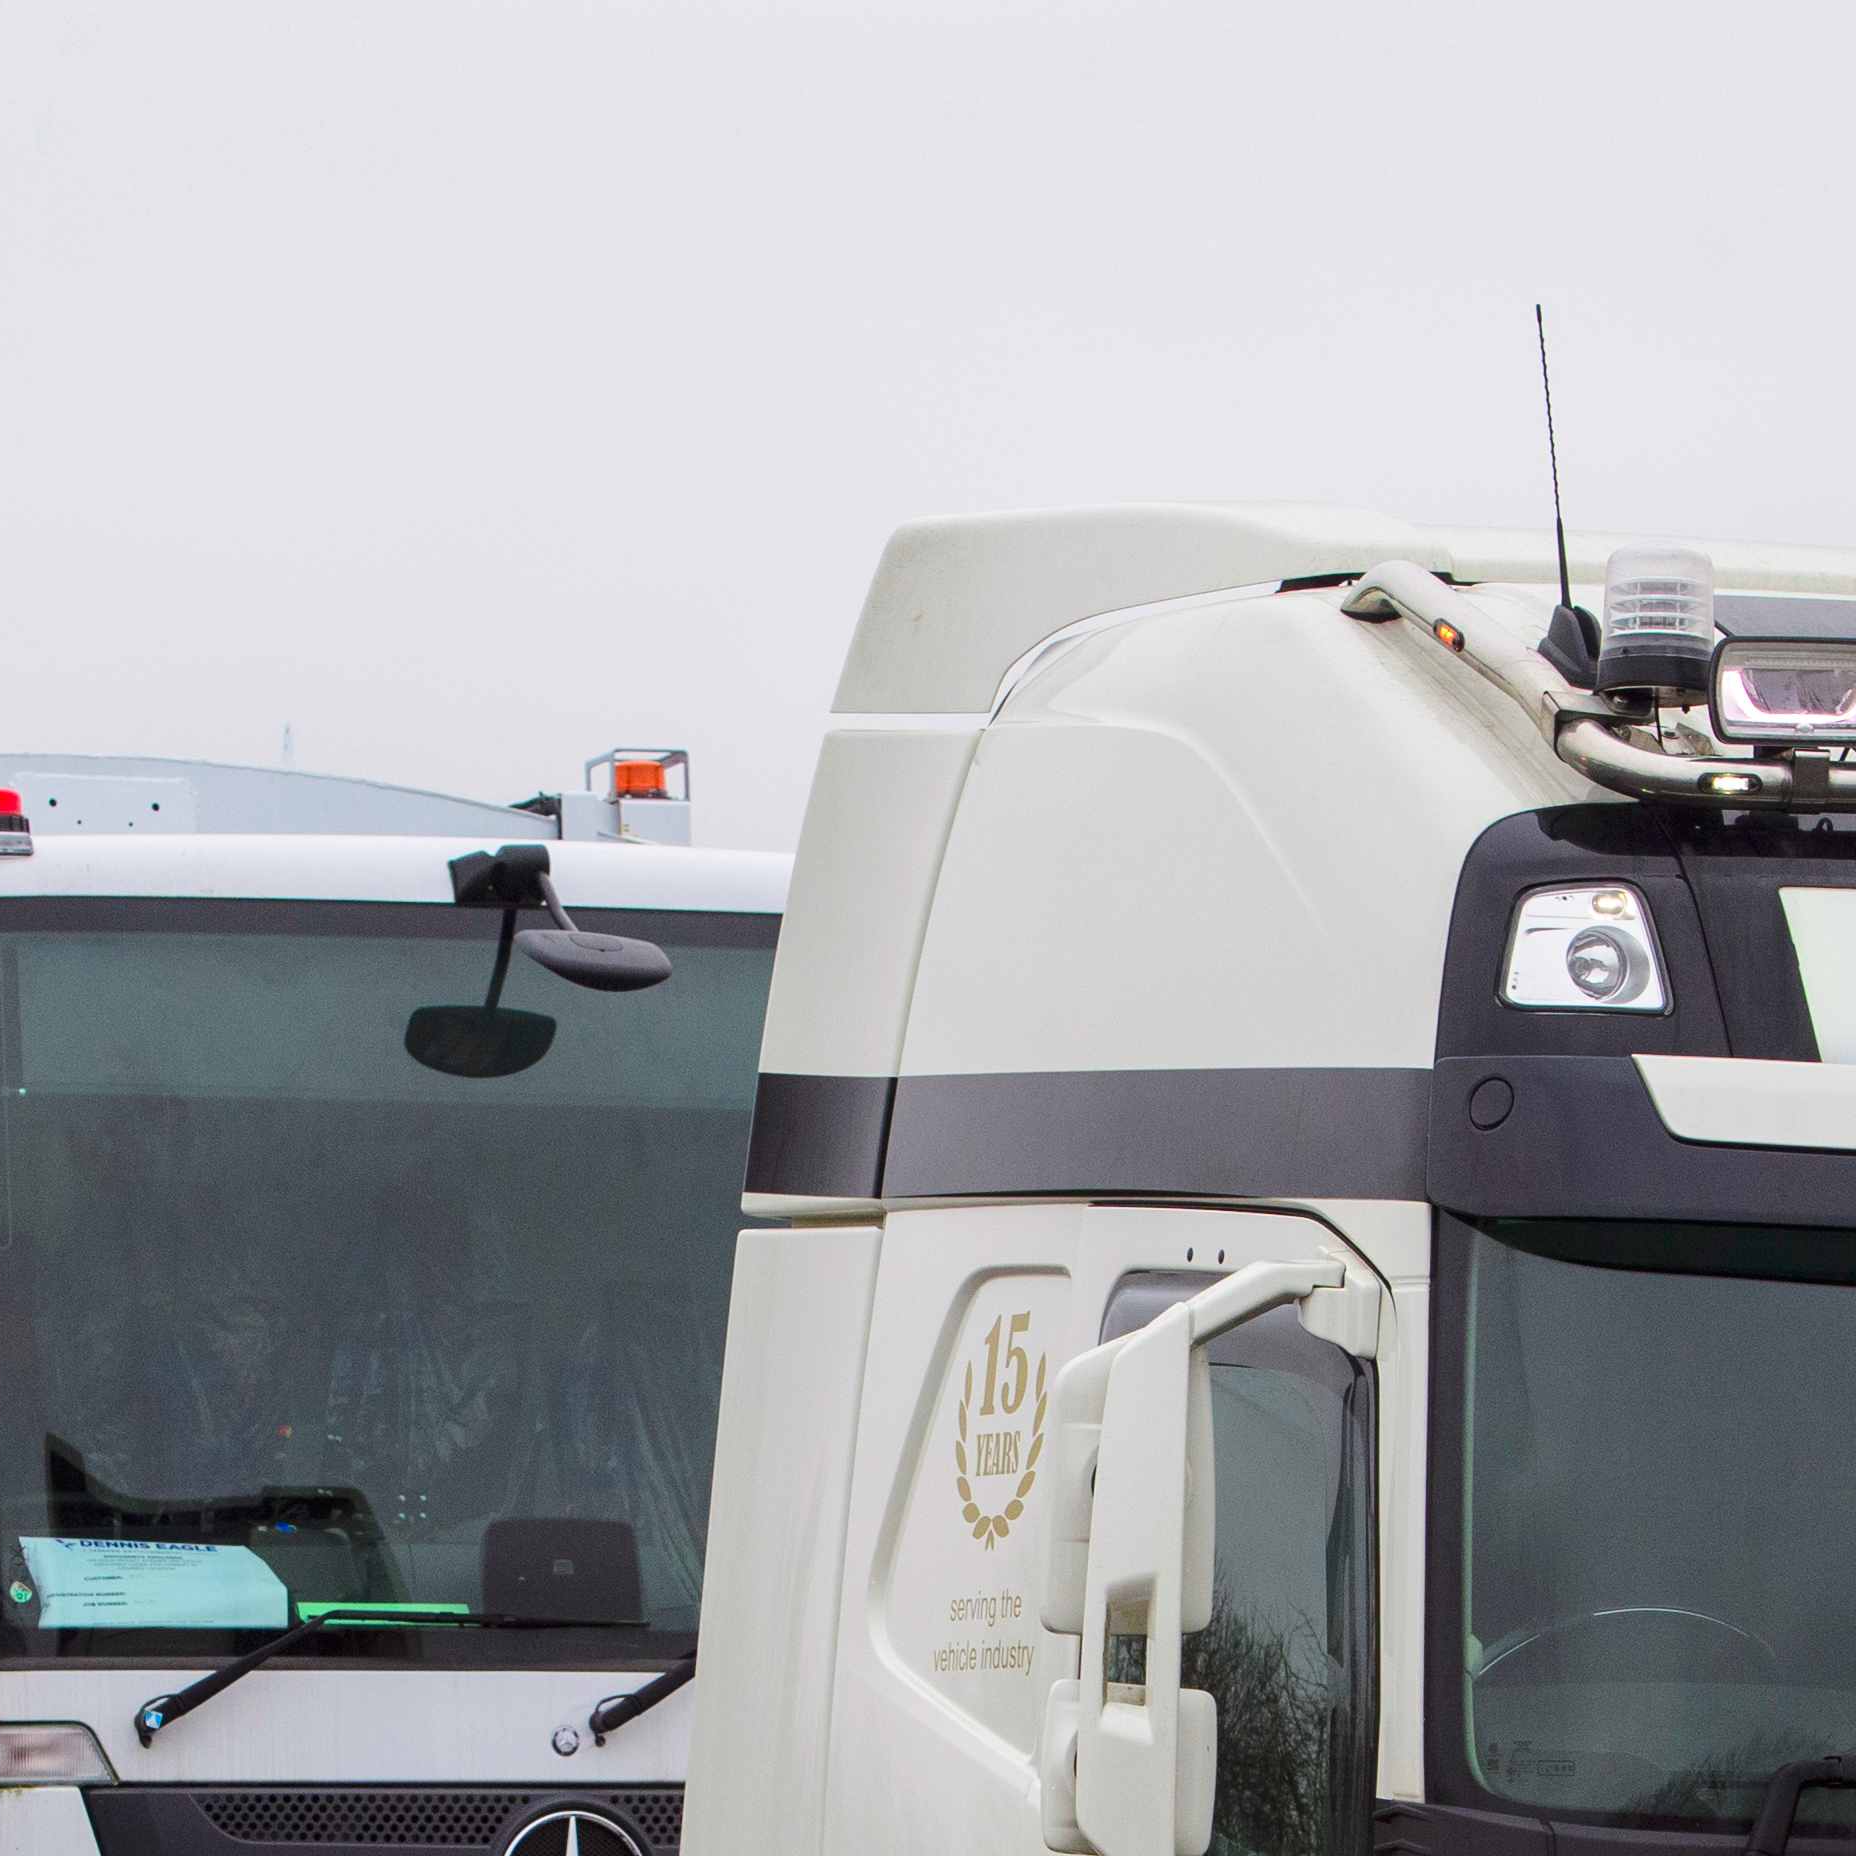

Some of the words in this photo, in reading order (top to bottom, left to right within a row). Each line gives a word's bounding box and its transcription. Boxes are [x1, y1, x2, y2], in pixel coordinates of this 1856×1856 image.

[979, 1311, 1031, 1416] 15
[975, 1430, 1022, 1477] YEARS
[80, 1539, 150, 1549] DENNIS
[155, 1543, 217, 1552] EAGLE
[950, 1592, 997, 1627] serving
[1000, 1592, 1023, 1620] the
[934, 1643, 978, 1672] vehicle
[981, 1641, 1035, 1677] industry
